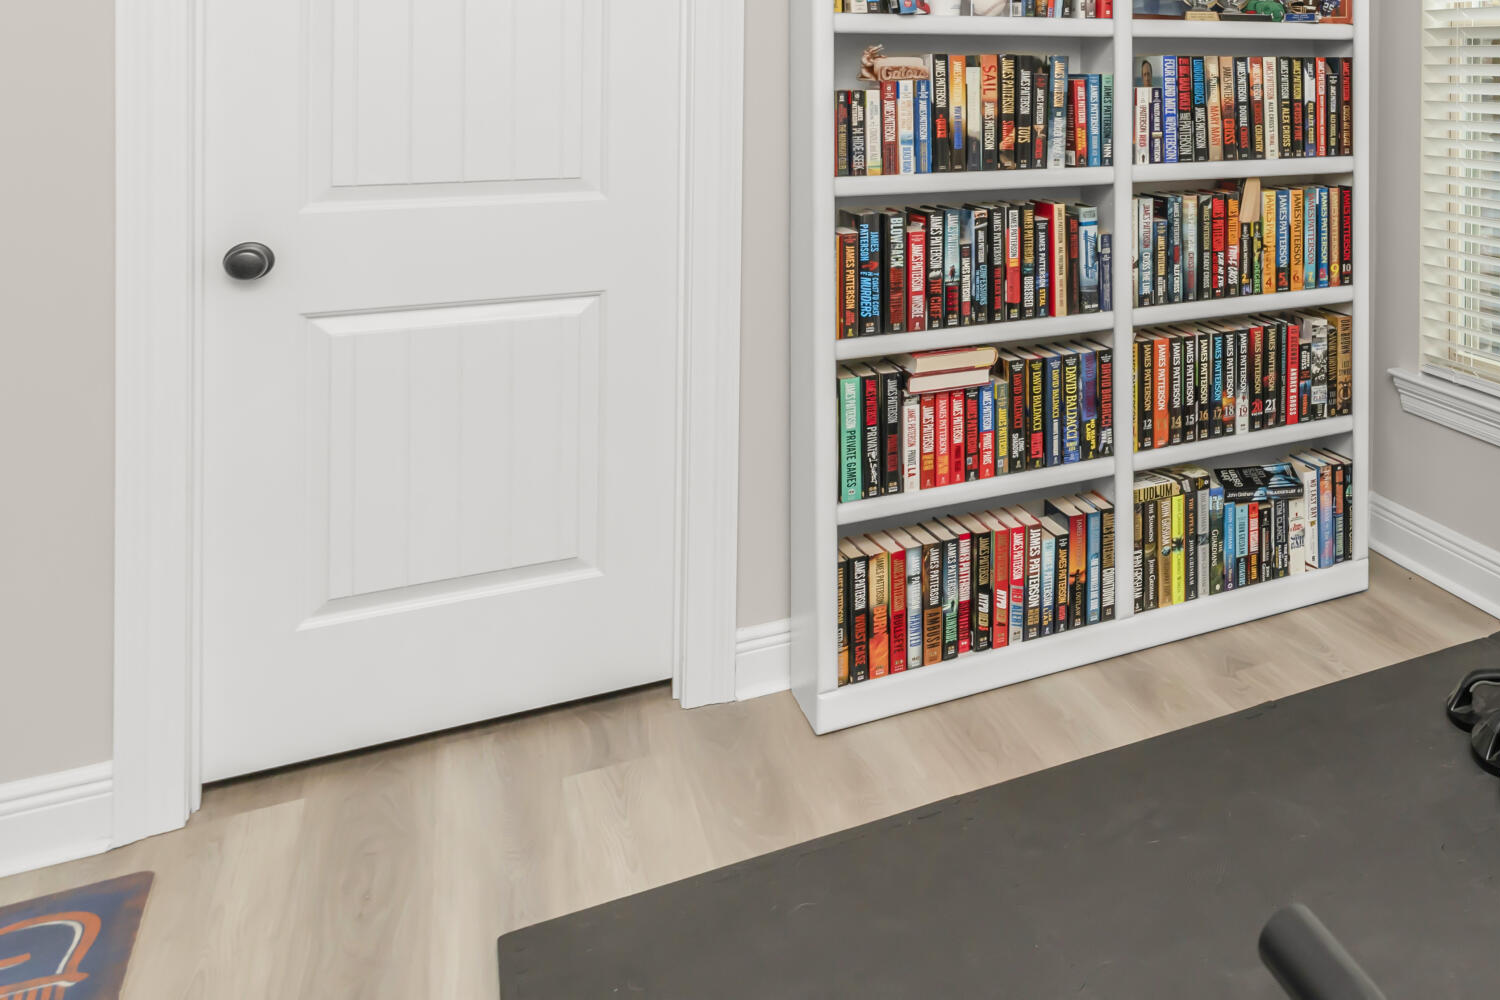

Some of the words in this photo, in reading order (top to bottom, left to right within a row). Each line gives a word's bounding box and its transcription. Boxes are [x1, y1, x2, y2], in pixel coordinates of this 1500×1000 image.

[1002, 58, 1014, 78] JAMES
[1165, 59, 1175, 76] FOUR
[1193, 59, 1204, 81] LONDON
[983, 65, 996, 95] SAIL
[1165, 78, 1175, 97] BLIND
[1179, 78, 1190, 91] BAD
[1002, 80, 1014, 114] PATTERSON
[1104, 86, 1112, 103] JAMES
[1179, 92, 1191, 111] WOLF
[1194, 82, 1204, 104] BRIDGES
[1165, 98, 1175, 115] MICE
[1210, 106, 1219, 124] MARY
[1239, 106, 1248, 127] DOUBLE
[1282, 108, 1290, 123] ALEX
[1018, 126, 1030, 143] TOYS
[1166, 123, 1176, 160] PATTERSON
[1179, 121, 1191, 155] PATTERSON
[1211, 127, 1220, 146] MARY
[1224, 118, 1235, 144] CROSS
[1255, 124, 1263, 152] COUNTRY
[1282, 125, 1290, 147] CROSS
[1279, 195, 1287, 220] JAMES
[1292, 194, 1301, 218] JAMES
[930, 214, 942, 235] JAMES
[993, 212, 1001, 231] JAMES
[1024, 210, 1032, 229] JAMES
[860, 223, 869, 261] PATTERSON
[870, 232, 878, 252] JAMES
[890, 217, 903, 268] BLOWBACK
[912, 243, 923, 261] JAMES
[930, 236, 942, 269] PATTERSON
[1024, 229, 1033, 263] PATTERSON
[1279, 221, 1288, 267] PATTERSON
[1293, 220, 1301, 265] PATTERSON
[845, 245, 854, 267] JAMES
[1142, 252, 1150, 269] CROSS
[1342, 263, 1351, 272] 10
[1142, 272, 1150, 281] THE
[1330, 263, 1340, 277] 9
[846, 269, 855, 309] PATTERSON
[860, 277, 872, 317] MURDERS
[930, 278, 941, 294] THE
[1024, 276, 1033, 307] OBSESSED
[930, 296, 941, 319] CHEF
[947, 286, 959, 312] LOST
[1341, 319, 1350, 331] DAN
[1341, 334, 1351, 354] BROWN
[1014, 373, 1022, 394] DAVID
[1033, 371, 1041, 394] DAVID
[1066, 366, 1076, 393] DAVID
[1101, 363, 1111, 387] DAVID
[1158, 369, 1166, 410] PATTERSON
[1014, 396, 1023, 428] BALDACCI
[1033, 395, 1041, 431] BALDACCI
[1101, 389, 1112, 427] BALDACCI
[1265, 399, 1275, 410] 21
[1066, 395, 1077, 439] BALDACCI
[846, 430, 856, 460] PRIVATE
[847, 463, 856, 487] GAMES
[1310, 479, 1317, 488] NO
[1138, 481, 1173, 501] LUDLUM
[1161, 501, 1170, 517] JOHN
[1013, 532, 1023, 550] JAMES
[1029, 529, 1040, 556] JAMES
[1161, 519, 1170, 546] GRISHAM
[929, 548, 939, 569] JAMES
[1013, 551, 1023, 580] PATTERSON
[930, 570, 939, 605] PATTERSON
[1029, 558, 1040, 608] PATTERSON
[1102, 568, 1114, 606] COUNTDOWN
[1012, 588, 1022, 603] RED
[873, 605, 886, 635] BURN
[945, 612, 956, 643] BLINDSIDE
[1011, 605, 1022, 627] ALERT
[855, 613, 866, 643] WORST
[894, 614, 904, 654] BULLSEYE
[909, 615, 921, 648] HAUNTED
[927, 612, 940, 649] AMBUSH
[856, 645, 866, 666] CASE
